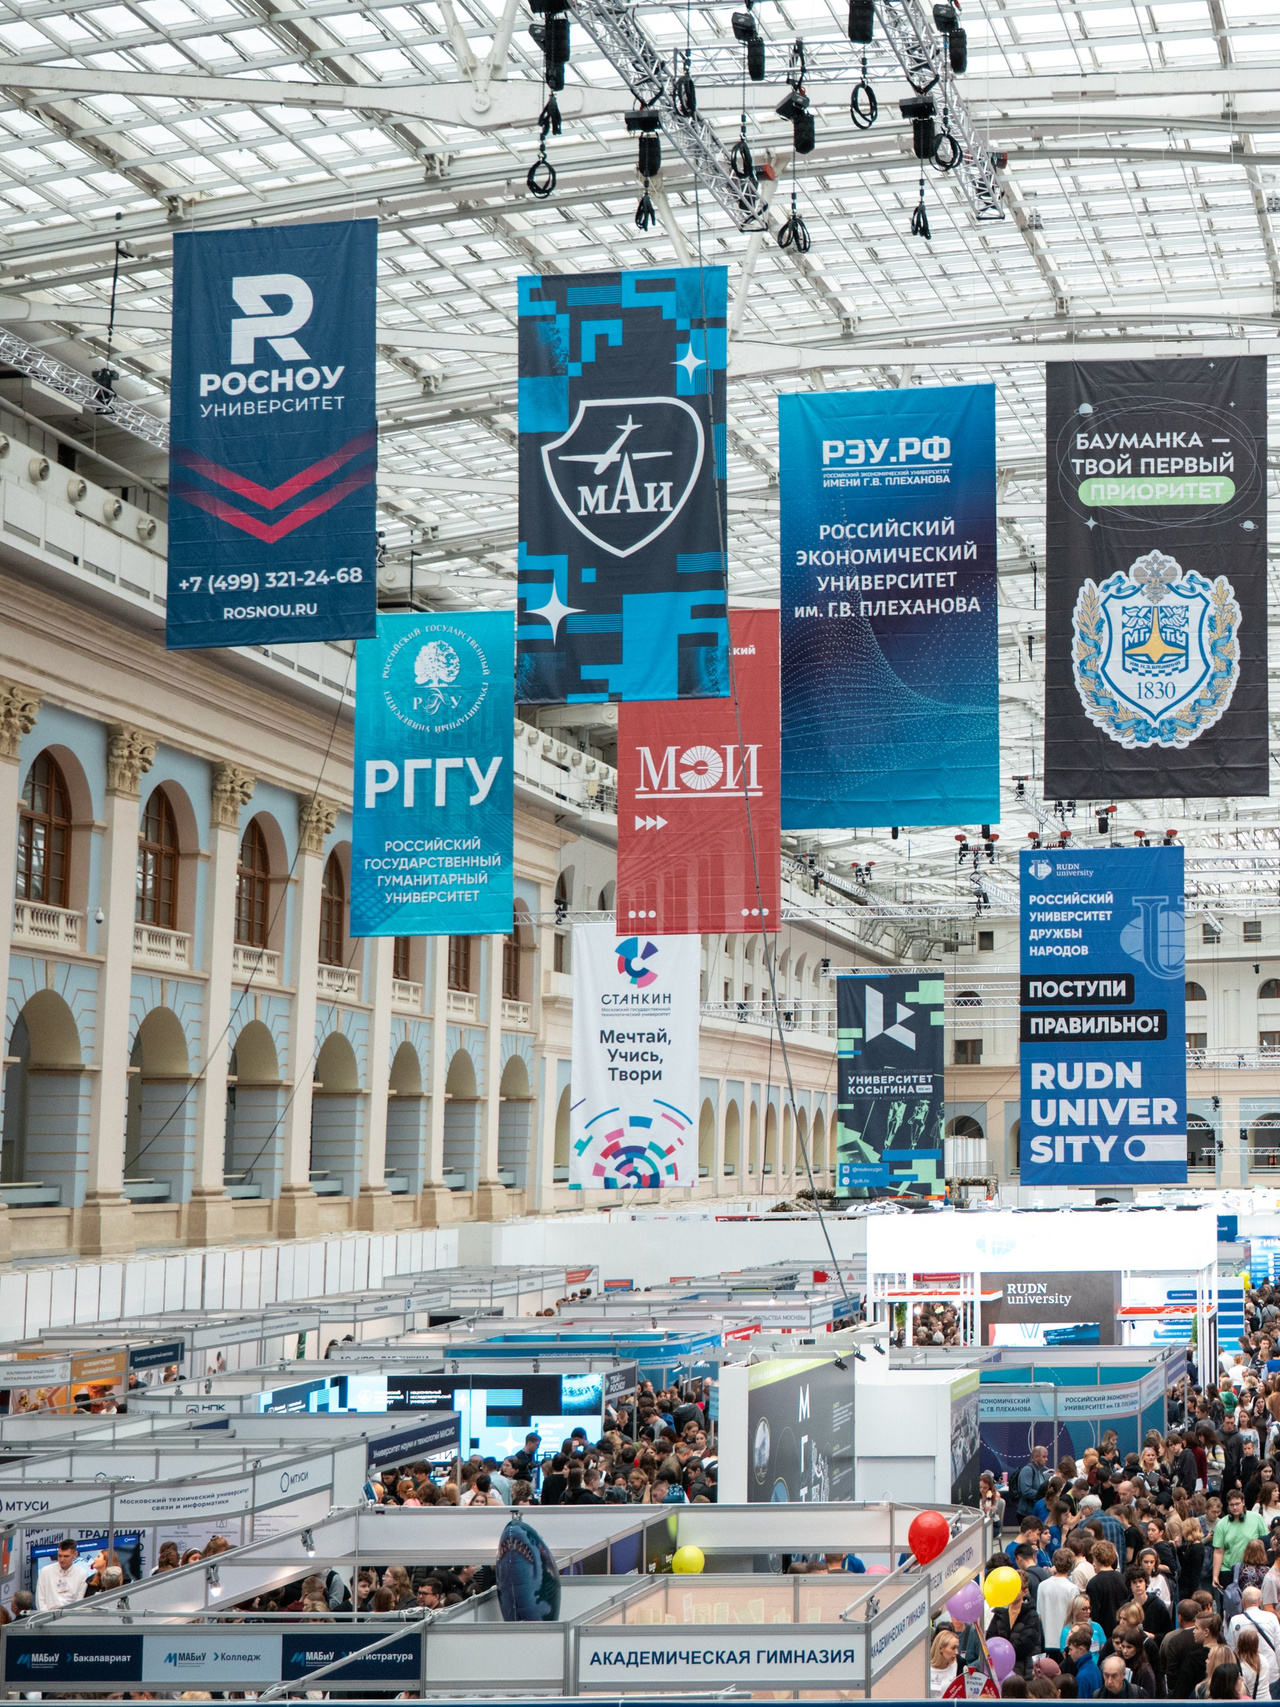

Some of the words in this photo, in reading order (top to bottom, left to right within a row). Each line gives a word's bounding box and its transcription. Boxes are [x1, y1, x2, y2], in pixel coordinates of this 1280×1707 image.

[200, 365, 345, 397] РОСНОУ
[200, 395, 345, 417] УНИВЕРСИТЕТ
[822, 436, 952, 465] РЭУ.РФ
[1075, 432, 1204, 452] БАУМАНКА
[1072, 454, 1132, 476] ТВОЙ
[1140, 452, 1234, 475] ПЕРВЫЙ
[577, 453, 674, 515] МАИ
[823, 478, 860, 487] ИМЕНИ
[885, 474, 951, 485] ПЛЕХАНОВА
[1090, 482, 1225, 501] ПРИОРИТЕТ
[819, 516, 955, 540] РОССИЙСКИЙ
[796, 541, 978, 566] ЭКОНОМИЧЕСКИЙ
[178, 575, 202, 592] +7
[208, 573, 260, 595] (499)
[265, 567, 363, 590] 321-24-68
[817, 572, 957, 592] УНИВЕРСИТЕТ
[223, 602, 318, 619] ROSNOU.RU
[828, 602, 855, 617] Г.В.
[861, 597, 981, 617] ПЛЕХАНОВА
[382, 628, 421, 679] РОССИЙСКИЙ
[425, 624, 491, 676] ГОСУДАРСТВЕННЫЙ
[1136, 681, 1176, 700] 1830
[383, 690, 431, 733] УНИВЕРСИТЕТ
[434, 682, 489, 733] ГУМАНИТАРНЫЙ
[364, 756, 504, 809] РГГУ
[385, 836, 481, 852] РОССИЙСКИЙ
[364, 853, 501, 870] ГОСУДАРСТВЕННЫЙ
[377, 871, 488, 887] ГУМАНИТАРНЫЙ
[1056, 868, 1094, 877] university
[385, 889, 480, 904] УНИВЕРСИТЕТ
[1029, 891, 1113, 905] РОССИЙСКИЙ
[1029, 910, 1113, 922] УНИВЕРСИТЕТ
[1029, 928, 1082, 941] ДРУЖБЫ
[1029, 945, 1089, 957] НАРОДОВ
[1029, 980, 1126, 998] ПОСТУПИ
[601, 993, 671, 1005] СТАНКИН
[1031, 1016, 1159, 1034] ПРАВИЛЬНО!
[600, 1028, 672, 1046] Мечтай,
[607, 1048, 664, 1065] Учись,
[608, 1067, 663, 1085] Твори
[848, 1074, 933, 1085] УНИВЕРСИТЕТ
[1031, 1061, 1141, 1090] RUDN
[848, 1085, 915, 1095] КОСЫГИНА
[1031, 1097, 1177, 1126] UNIVER
[1007, 1283, 1048, 1294] RUDN
[1007, 1293, 1072, 1307] university
[1064, 1403, 1106, 1411] УНИВЕРСИТЕТ
[1065, 1395, 1105, 1403] РОССИЙСКИЙ
[373, 1444, 401, 1459] Университет
[417, 1431, 441, 1447] технологий
[440, 1426, 455, 1440] МИСИС
[119, 1497, 167, 1505] Московский
[168, 1493, 215, 1503] технический
[216, 1488, 250, 1500] университет
[151, 1503, 175, 1512] связи
[183, 1498, 229, 1511] информатики
[5, 1501, 49, 1512] МТУСИ
[871, 1619, 906, 1659] АКАДЕМИЧЕСКАЯ
[31, 1652, 60, 1663] МАБиУ
[73, 1653, 131, 1663] Бакалавриат
[178, 1652, 207, 1664] МАБиУ
[220, 1652, 261, 1664] Колледж
[306, 1651, 335, 1661] МАБиУ
[589, 1650, 751, 1668] АКАДЕМИЧЕСКАЯ
[756, 1649, 856, 1665] ГИМНАЗИЯ
